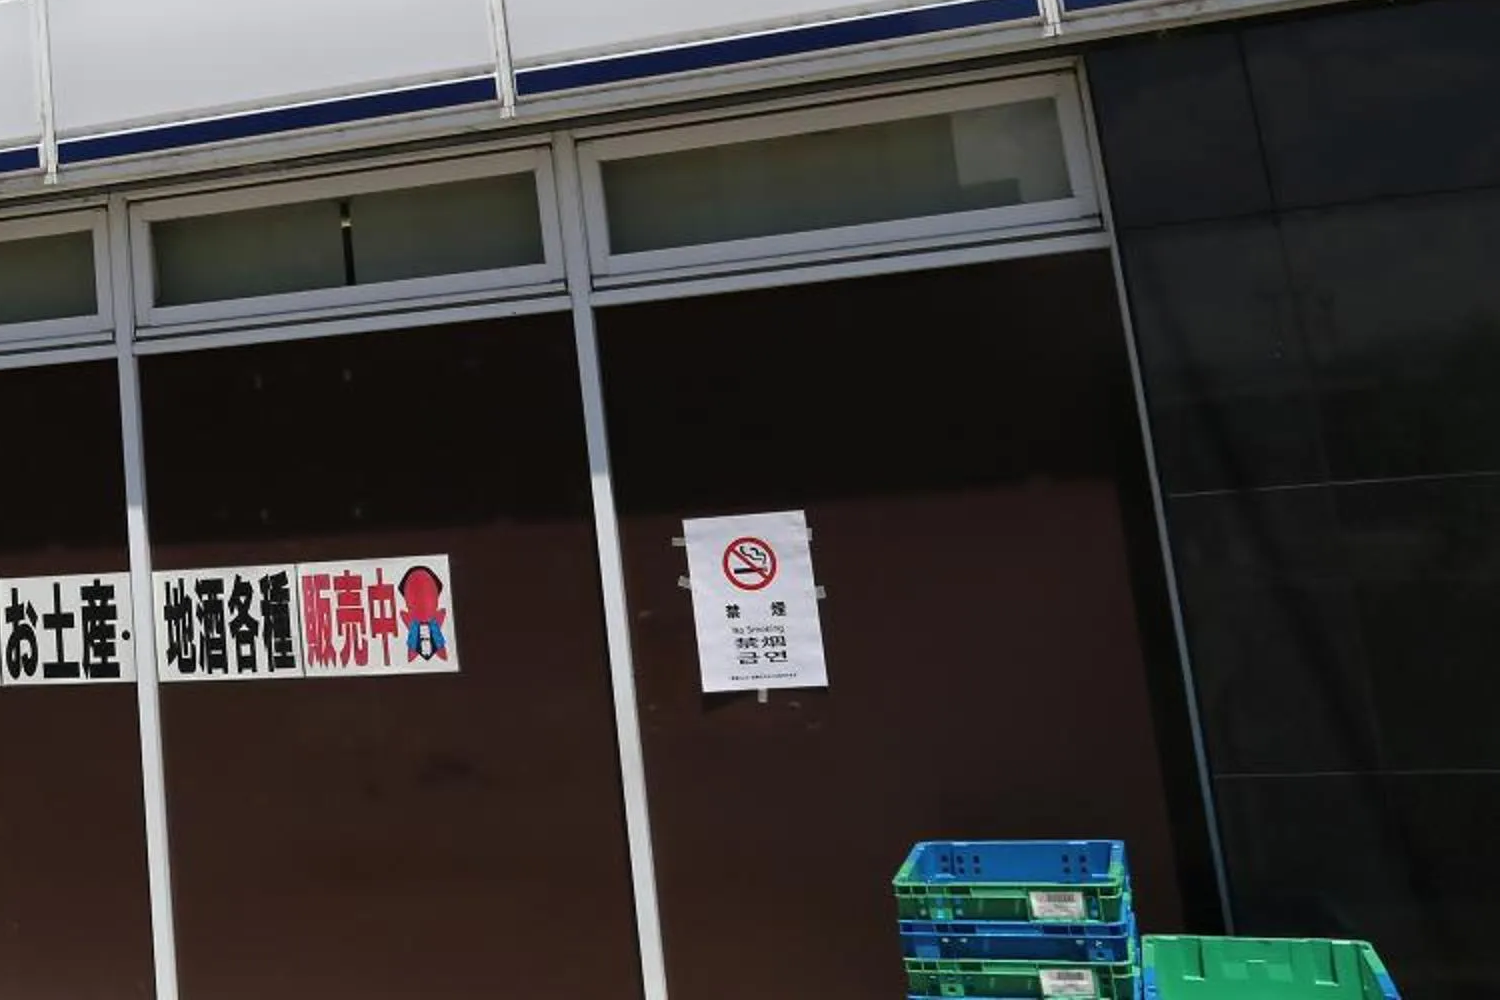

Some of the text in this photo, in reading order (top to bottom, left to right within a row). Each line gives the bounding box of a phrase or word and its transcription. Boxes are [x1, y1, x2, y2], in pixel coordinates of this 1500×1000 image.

[163, 567, 400, 676] 地酒各種販売中
